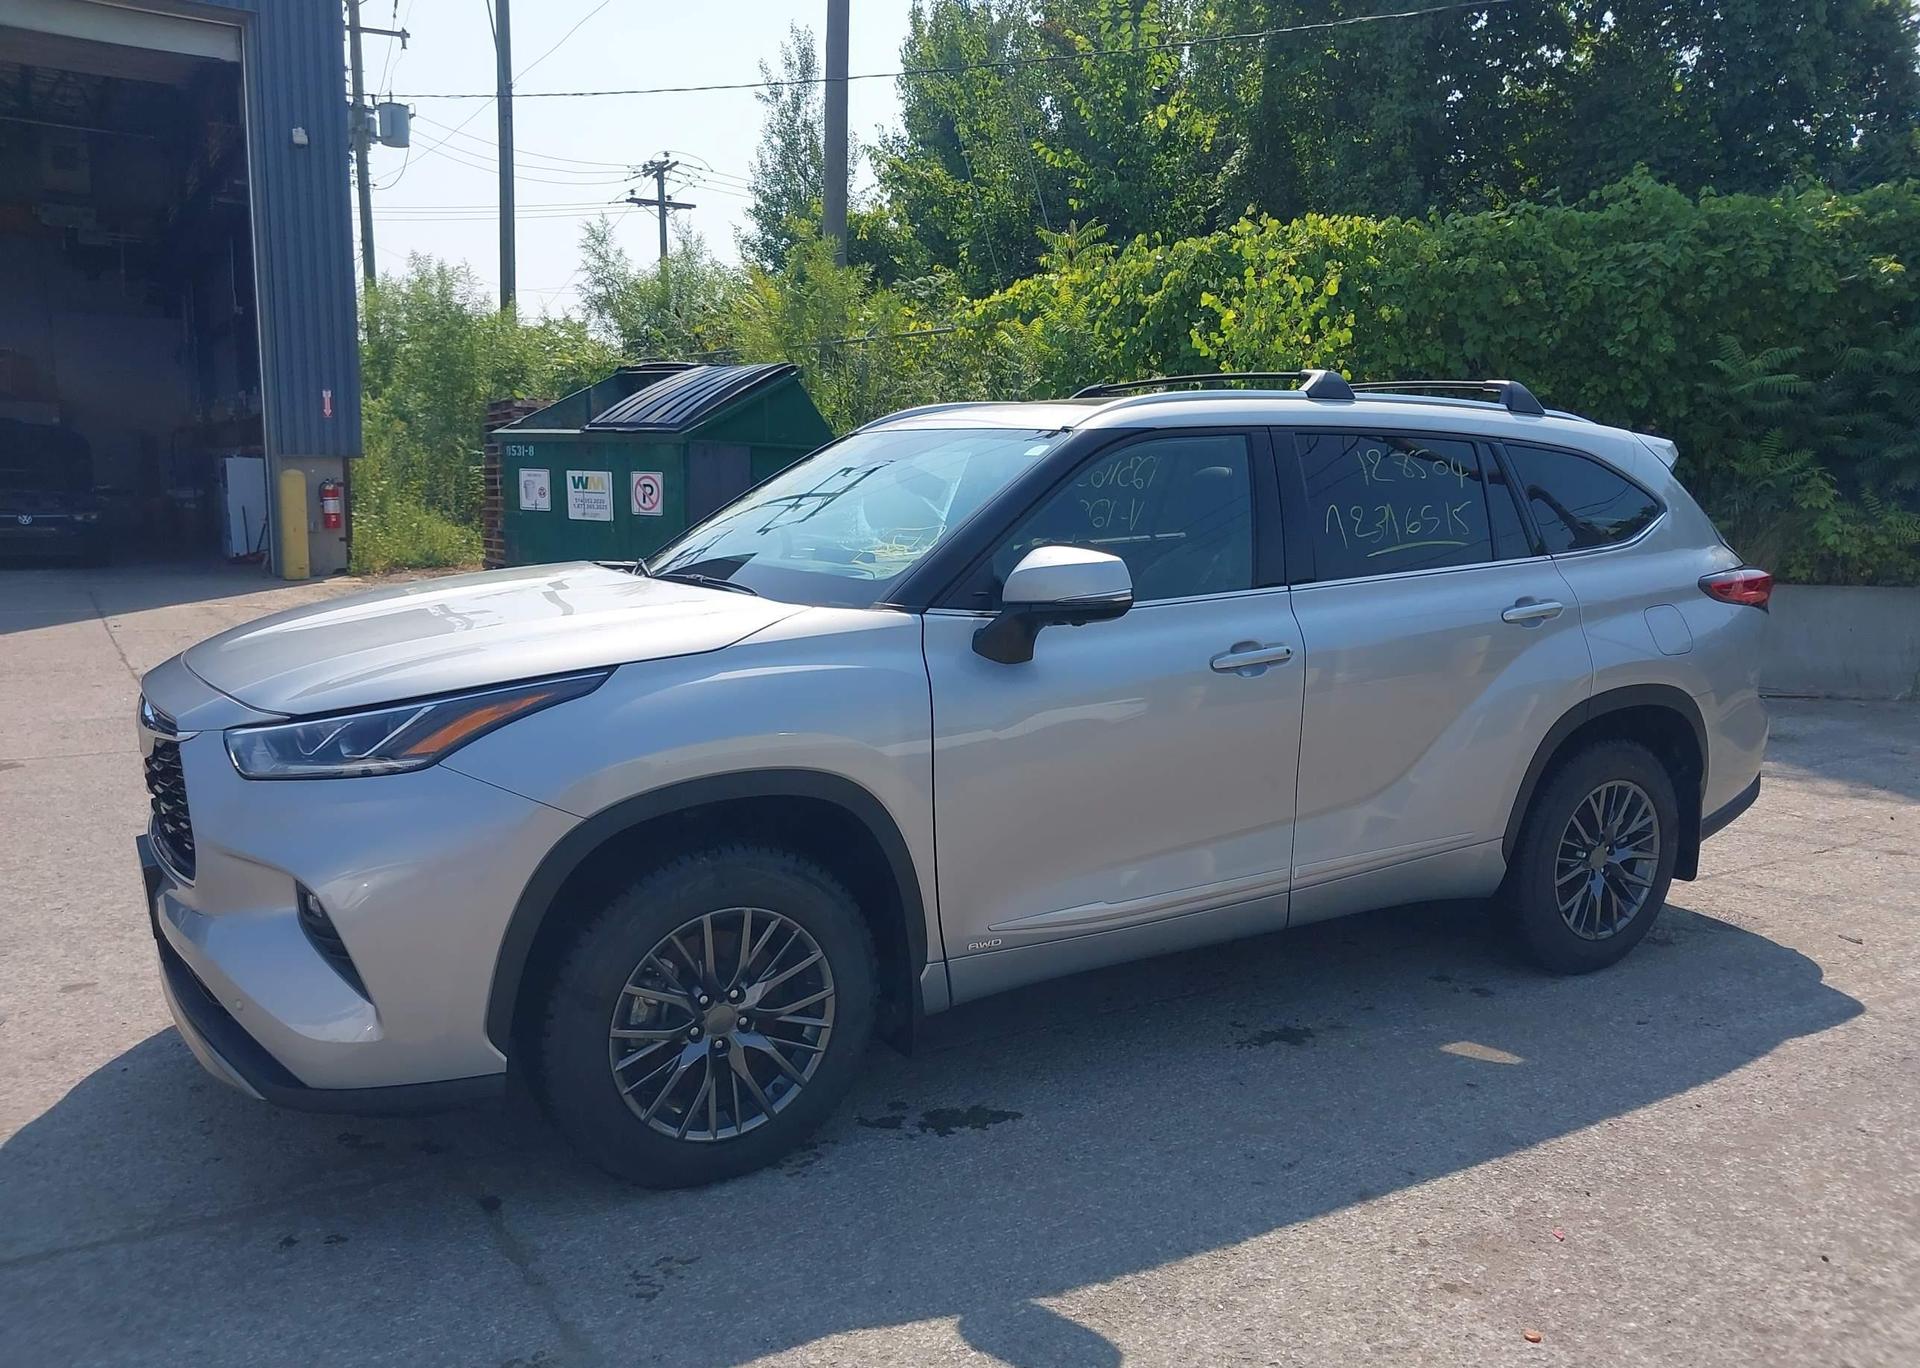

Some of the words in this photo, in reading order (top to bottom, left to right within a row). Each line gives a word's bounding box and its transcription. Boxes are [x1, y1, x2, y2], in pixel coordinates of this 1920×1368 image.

[571, 475, 605, 490] WM
[642, 483, 655, 505] P
[968, 938, 1002, 951] AWD
